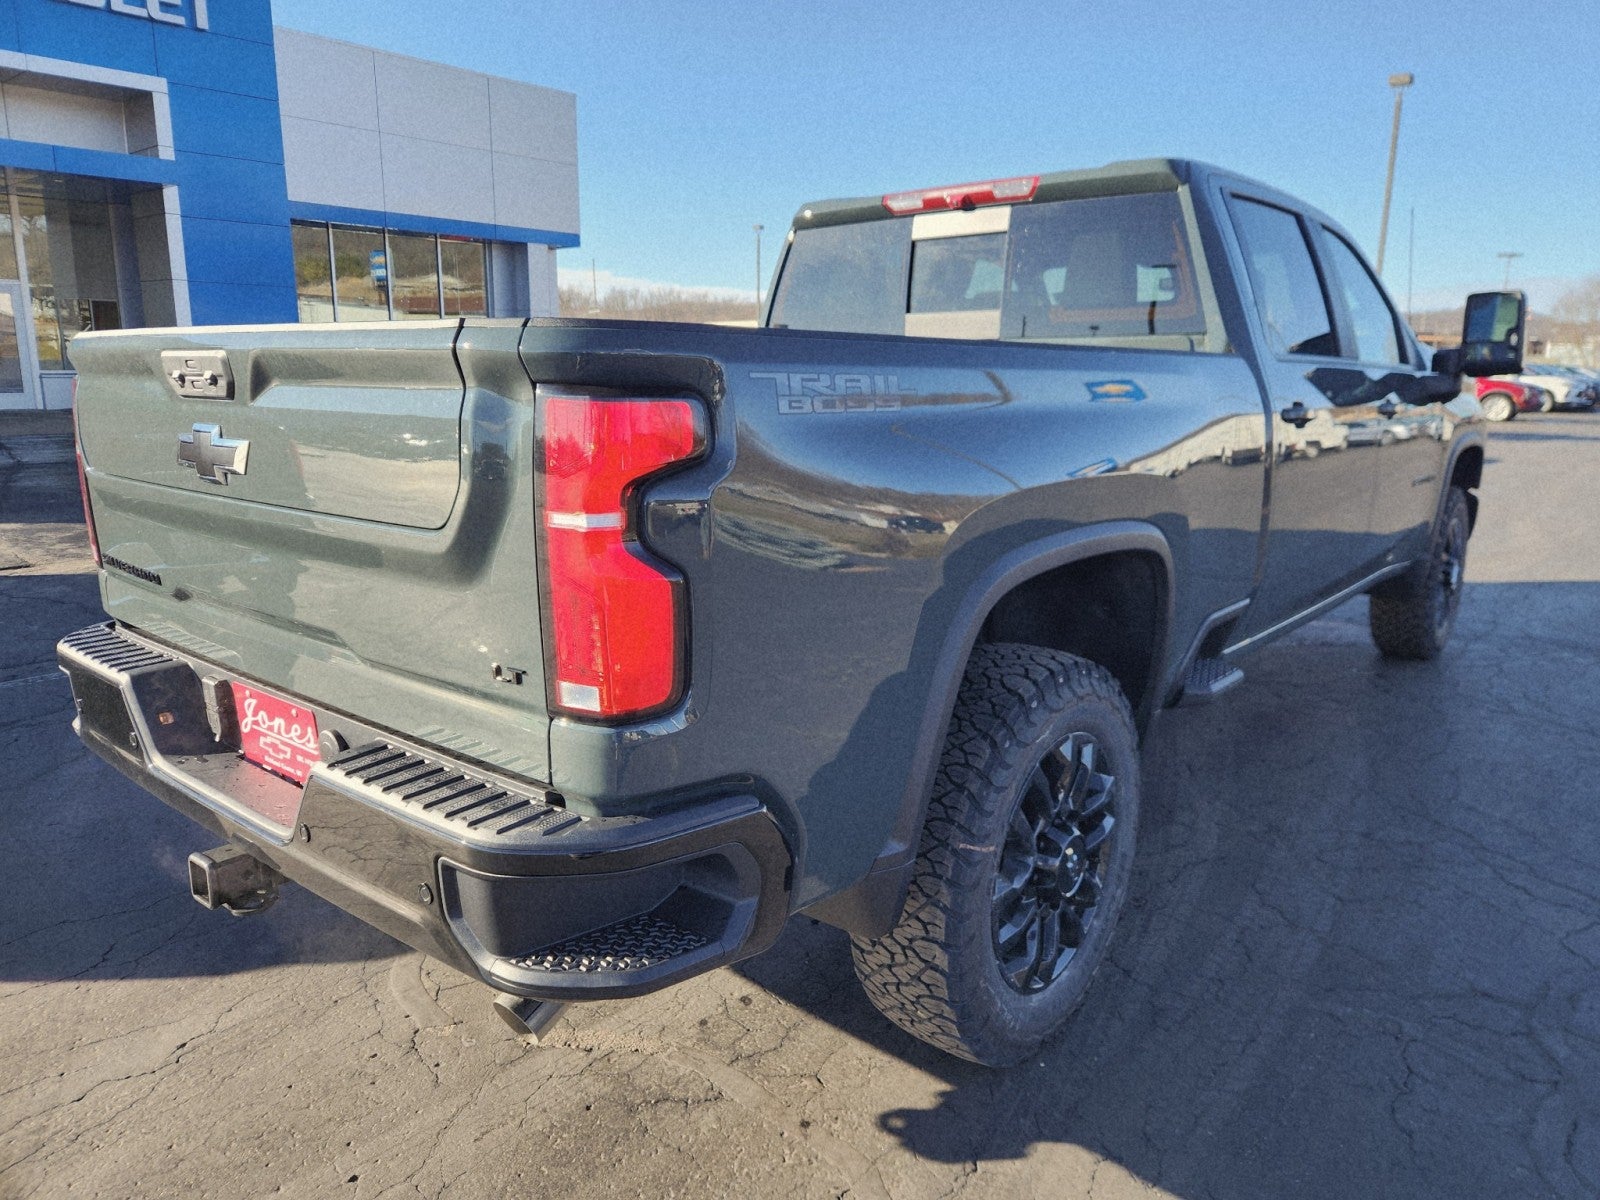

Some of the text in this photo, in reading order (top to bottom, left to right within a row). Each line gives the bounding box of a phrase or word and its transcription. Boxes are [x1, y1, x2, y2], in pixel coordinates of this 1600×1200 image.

[750, 371, 918, 398] TRAIL
[778, 395, 899, 415] BOSS
[492, 663, 528, 685] LT
[241, 698, 319, 749] Jones
